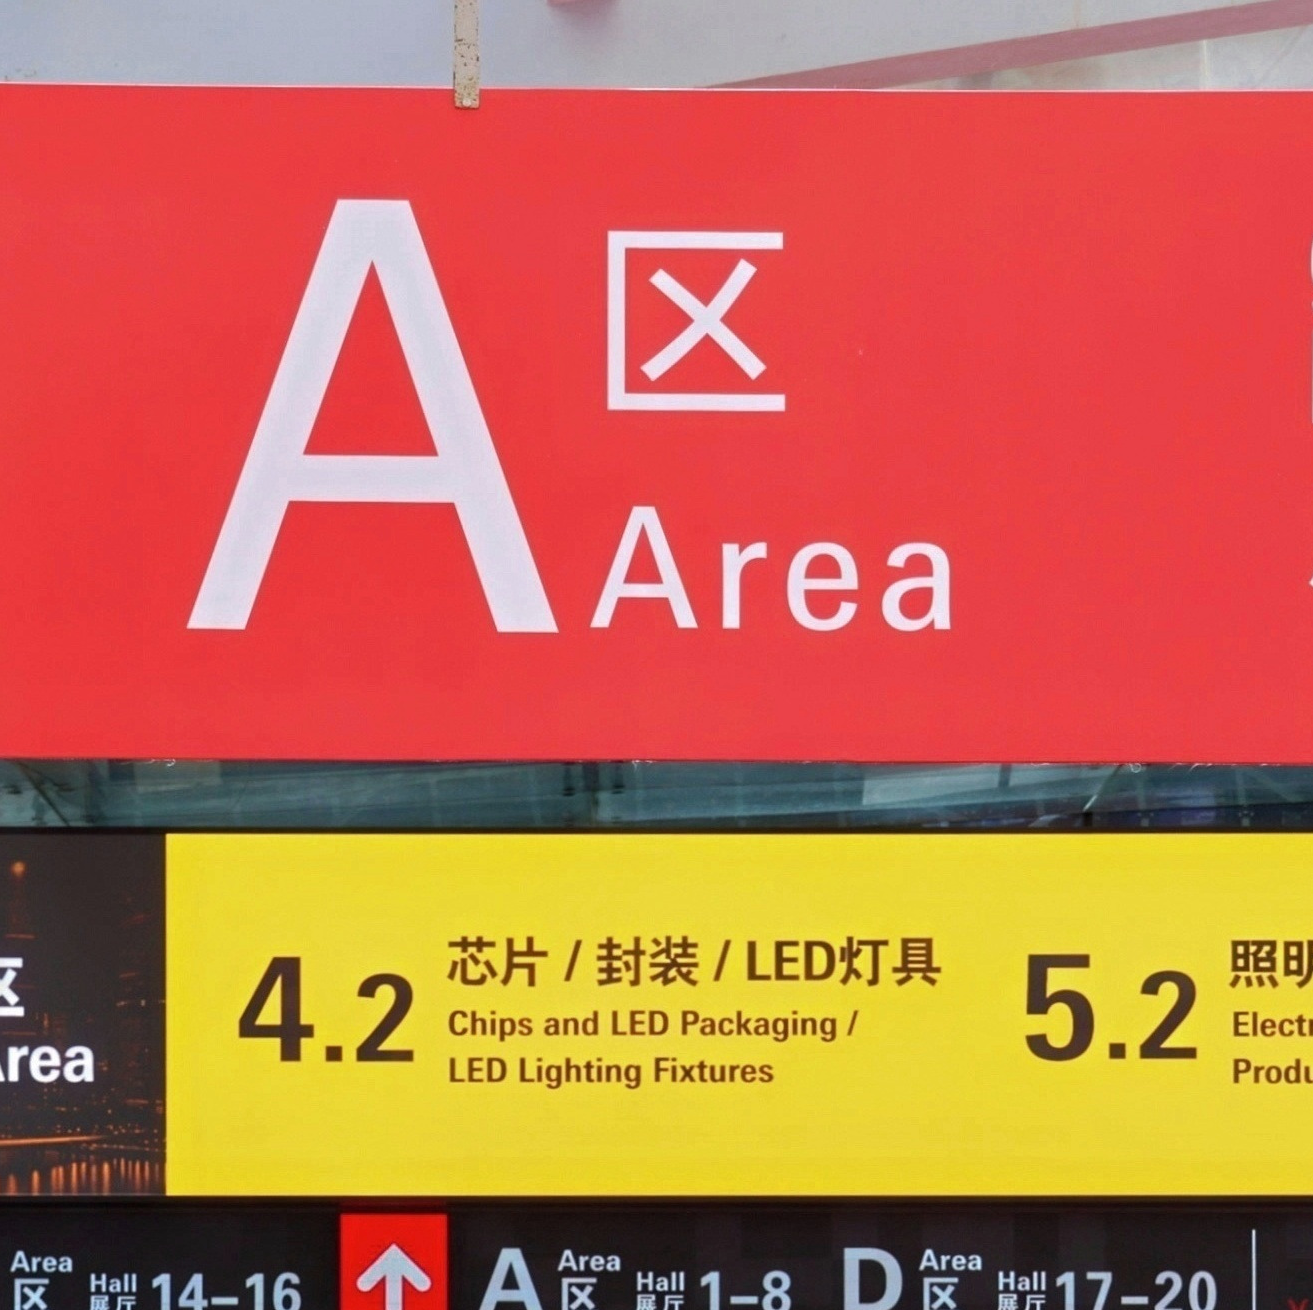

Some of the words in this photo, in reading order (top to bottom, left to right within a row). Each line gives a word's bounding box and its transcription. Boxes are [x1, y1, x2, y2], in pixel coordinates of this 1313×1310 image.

[607, 230, 786, 412] 区
[186, 199, 560, 633] A
[590, 505, 952, 632] Area
[447, 936, 548, 987] 芯片
[596, 936, 699, 987] 封装
[746, 936, 943, 987] LED灯具
[237, 956, 415, 1062] 4.2
[448, 1008, 534, 1042] Chips
[543, 1009, 600, 1037] and
[610, 1010, 670, 1037] LED
[681, 1008, 838, 1042] Packaging
[1024, 953, 1198, 1063] 5.2
[448, 1057, 507, 1084] LED
[518, 1056, 643, 1090] Lighting
[654, 1056, 775, 1084] Fixtures
[9, 1249, 74, 1274] Area
[557, 1249, 621, 1272] Area
[918, 1248, 983, 1272] Area
[89, 1271, 138, 1293] Hall
[636, 1271, 686, 1293] Hall
[997, 1271, 1047, 1293] Hall
